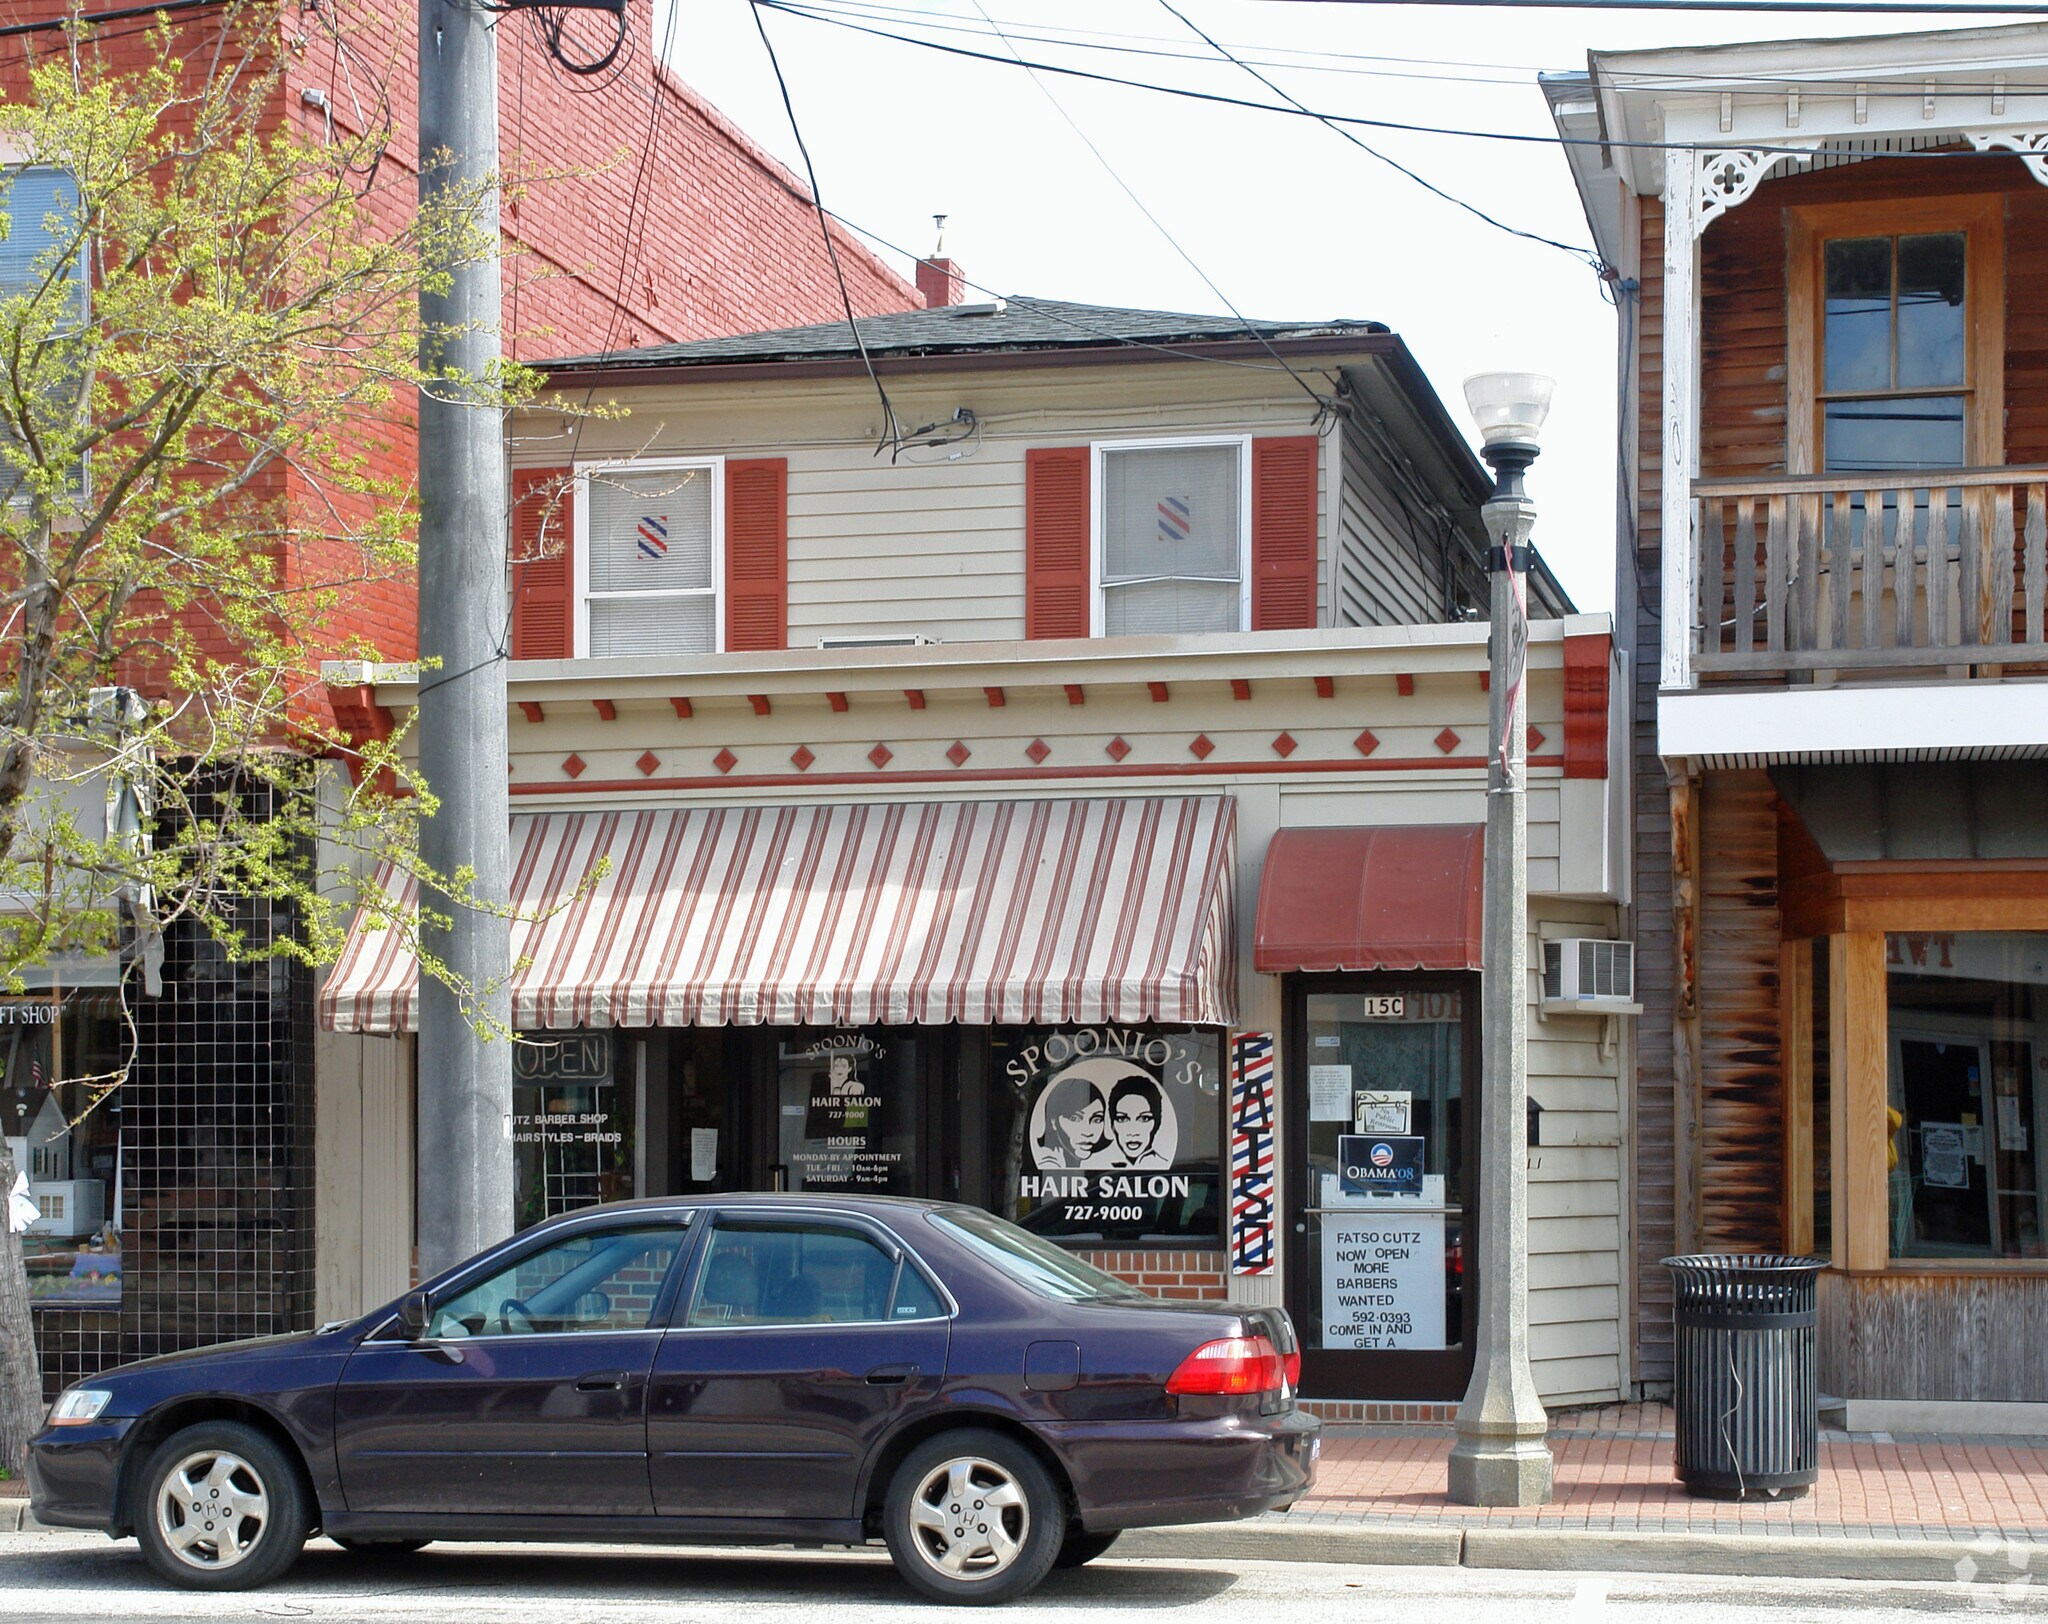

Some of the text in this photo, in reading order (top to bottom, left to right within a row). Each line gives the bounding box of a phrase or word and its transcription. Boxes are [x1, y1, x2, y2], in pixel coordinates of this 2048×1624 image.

[1368, 999, 1401, 1014] 15C
[806, 1034, 886, 1060] SPOONIO'S
[518, 1040, 598, 1073] OPEN
[1006, 1027, 1202, 1088] SPOONIO'S
[812, 1097, 882, 1107] HAIR SALON
[534, 1114, 576, 1124] BARBER
[580, 1114, 608, 1124] SHOP
[827, 1136, 866, 1146] HOURS
[1238, 1036, 1270, 1267] FATSO
[842, 1154, 902, 1162] APPOINTMENT
[1020, 1176, 1189, 1198] HAIR SALON
[1064, 1206, 1143, 1220] 727-9000
[1336, 1232, 1420, 1243] FATSO CUTZ
[1336, 1248, 1409, 1261] NOW OPEN
[1354, 1262, 1389, 1273] MORE
[1336, 1278, 1398, 1289] BARBERS
[1338, 1295, 1394, 1306] WANTED
[1329, 1324, 1412, 1336] COME IN AND
[1354, 1337, 1396, 1348] GET A
